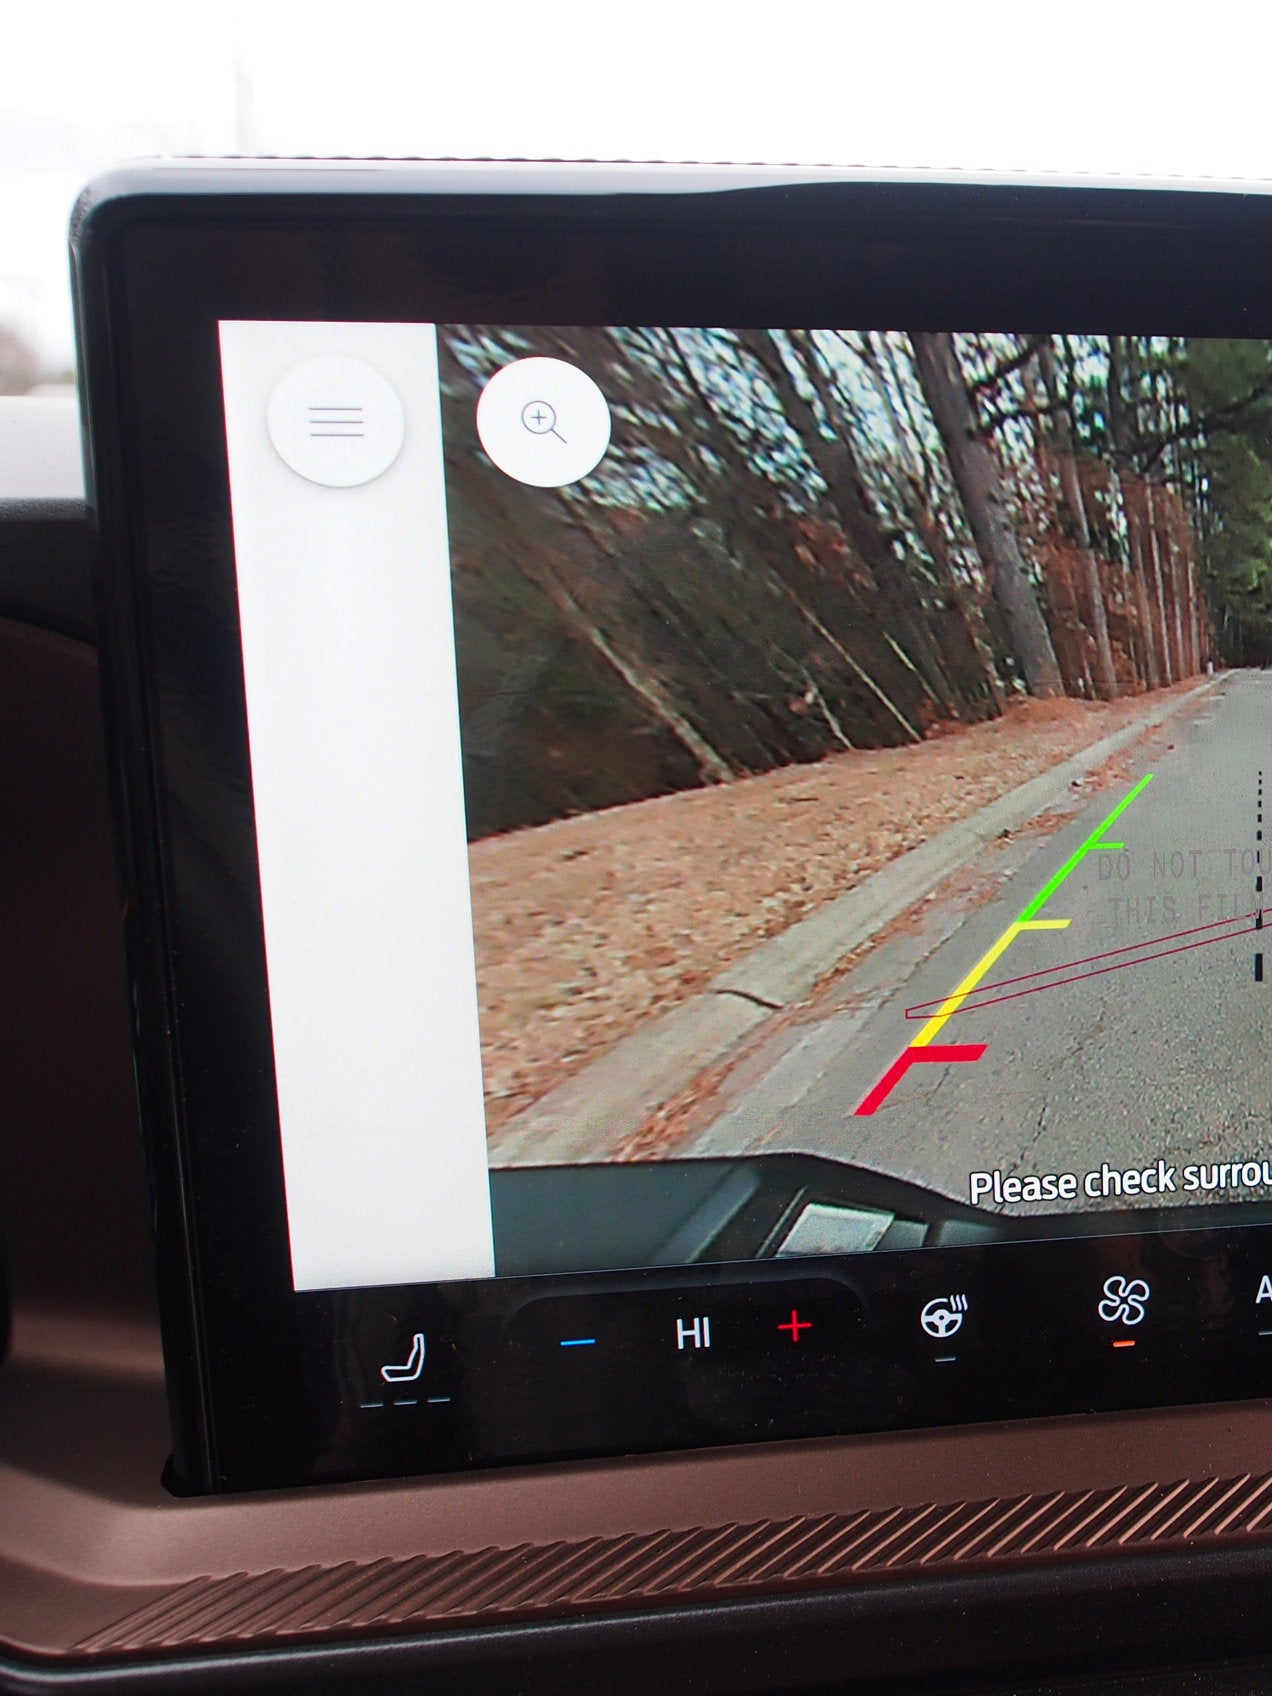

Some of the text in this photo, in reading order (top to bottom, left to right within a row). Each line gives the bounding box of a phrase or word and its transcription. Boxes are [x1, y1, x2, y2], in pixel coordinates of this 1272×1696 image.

[1097, 851, 1132, 881] DO
[1152, 849, 1202, 880] NOT
[1107, 895, 1178, 926] THIS
[970, 1168, 1078, 1205] Please
[1083, 1159, 1176, 1199] check
[676, 1316, 710, 1350] HI
